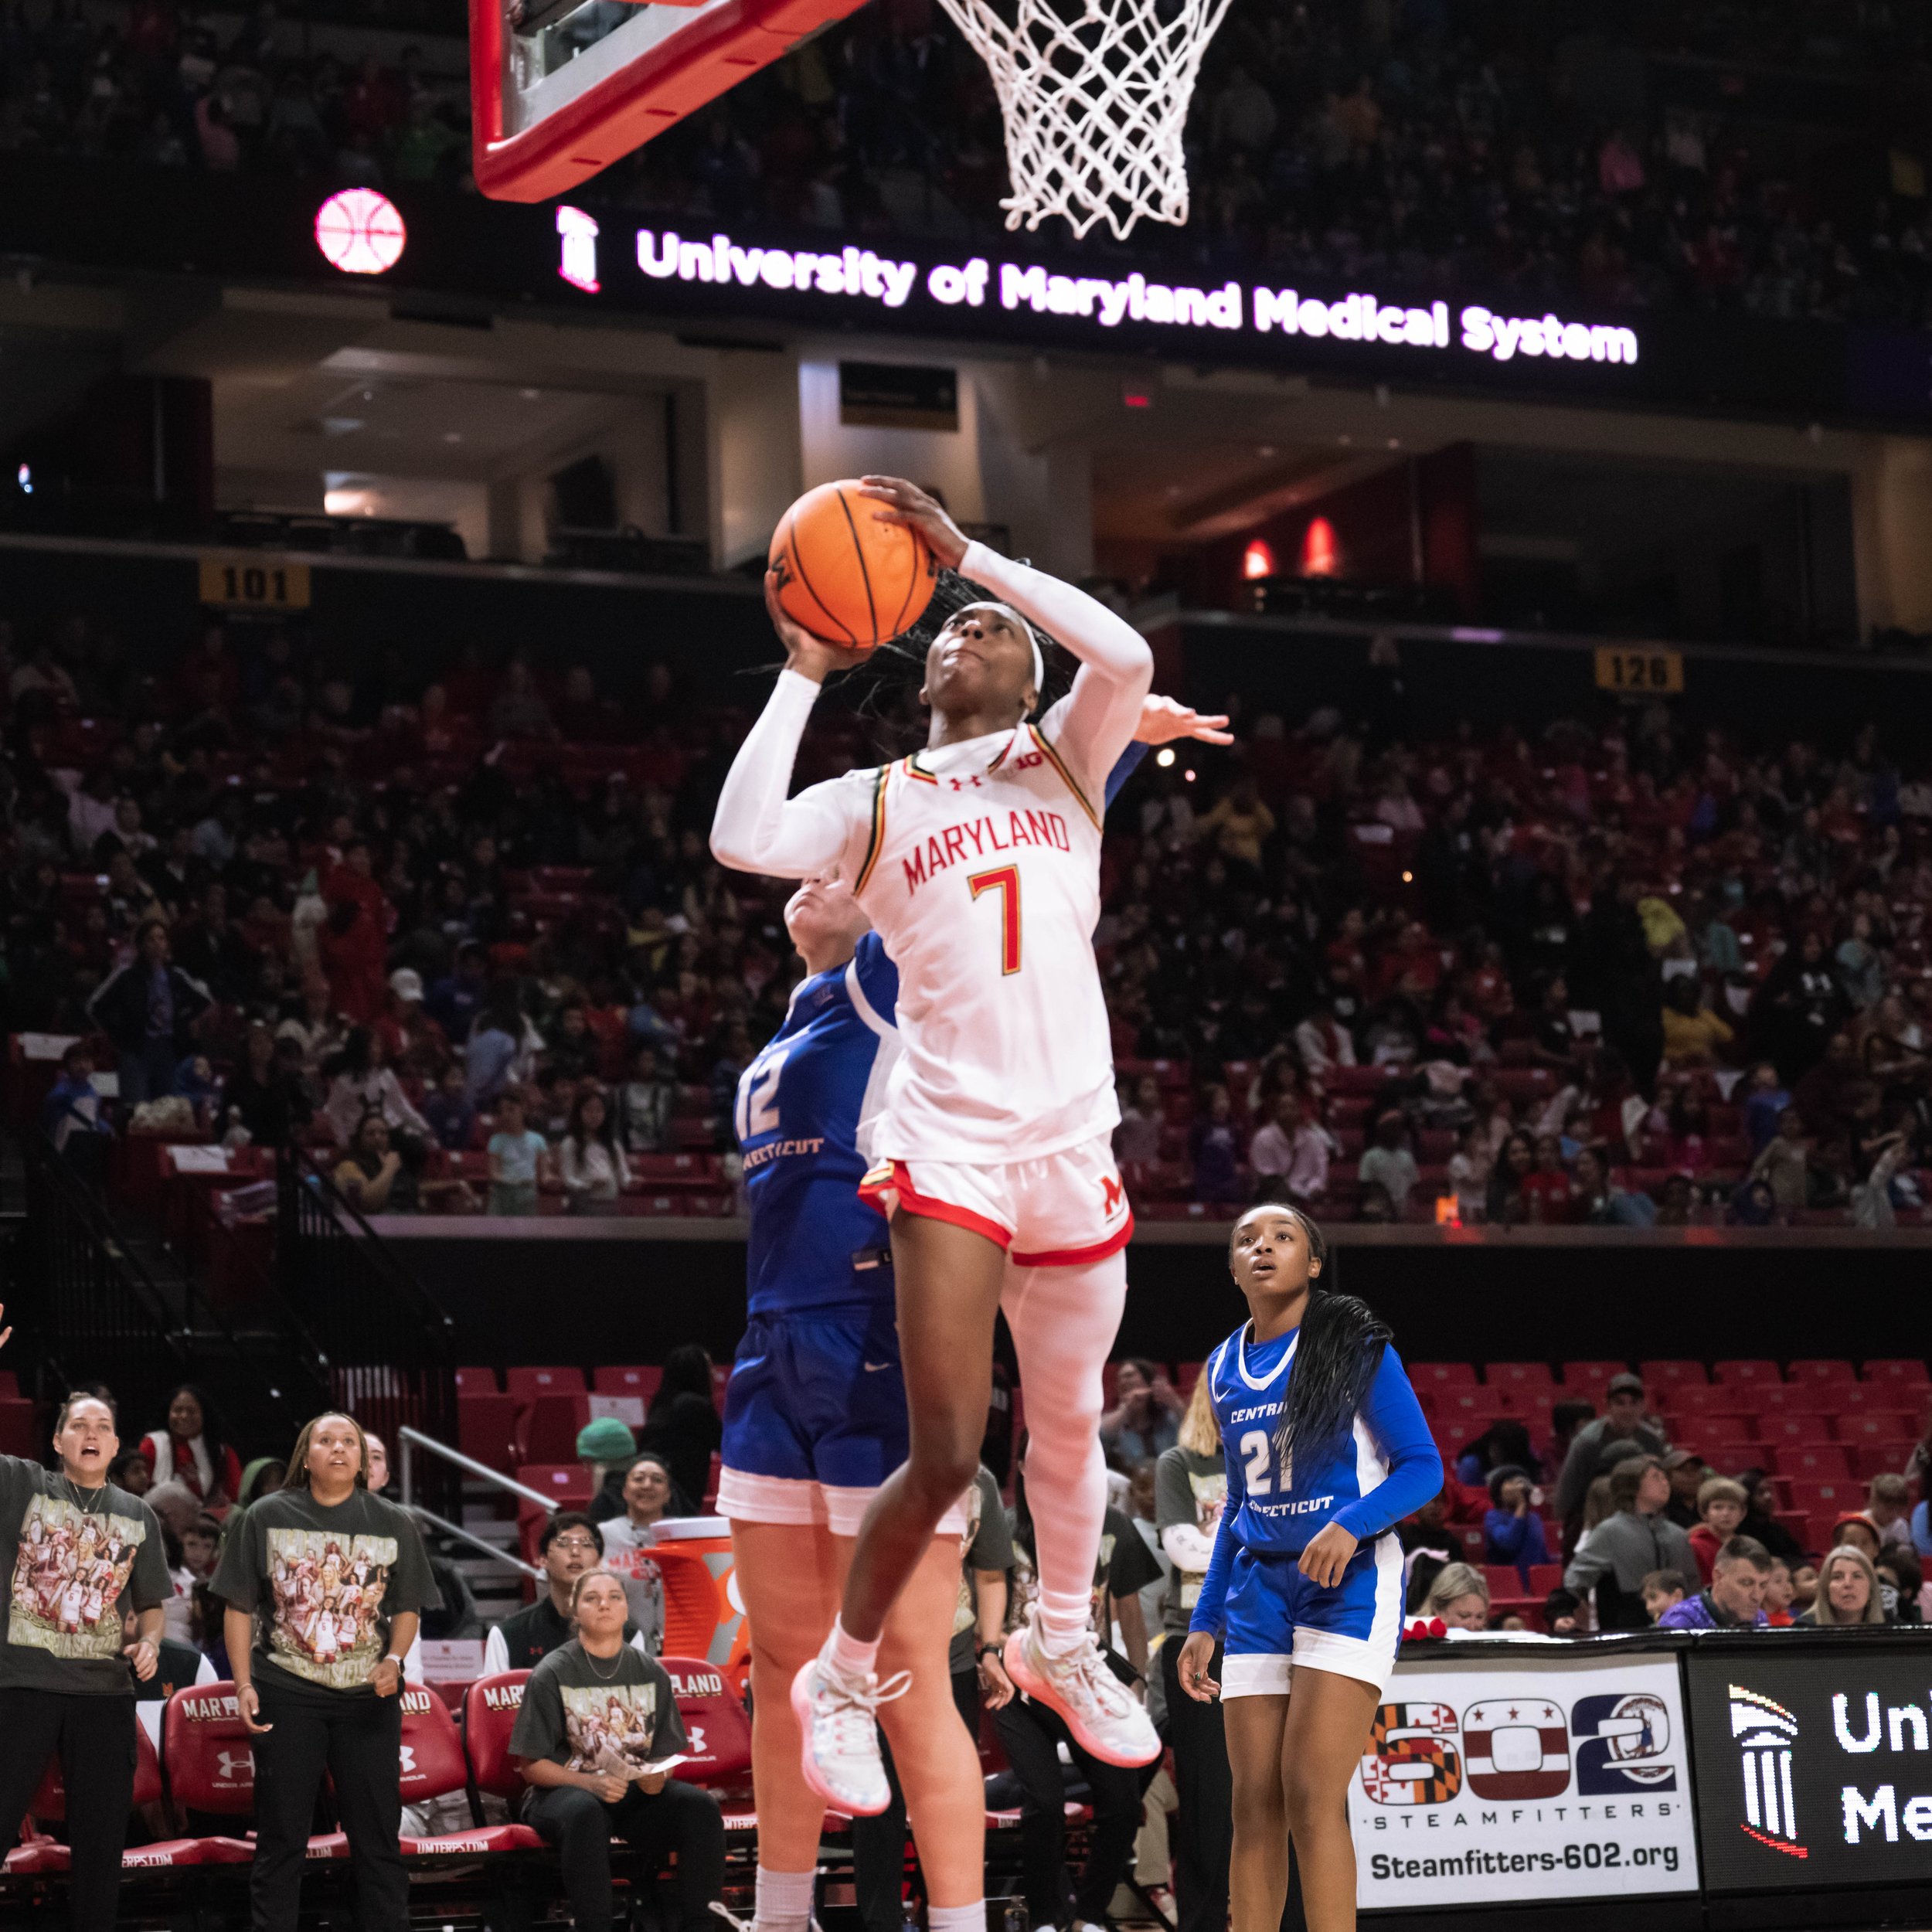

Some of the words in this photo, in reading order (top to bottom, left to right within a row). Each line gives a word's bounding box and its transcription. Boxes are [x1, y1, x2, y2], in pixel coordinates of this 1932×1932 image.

[637, 230, 916, 307] University
[928, 257, 989, 306] of
[1001, 264, 1243, 328] Maryland
[1253, 287, 1449, 348] Medical
[1461, 305, 1638, 364] System
[223, 566, 287, 601] 101
[1611, 655, 1668, 686] 126
[902, 808, 1070, 896] MARYLAND
[967, 863, 1021, 976] 7
[735, 1049, 791, 1142] 12
[1240, 1426, 1294, 1497] 21
[1361, 1693, 1677, 1806] 602
[1832, 1692, 1932, 1753] Un
[1373, 1801, 1672, 1831] STEAMFITTERS
[1841, 1785, 1932, 1844] Me
[1371, 1842, 1680, 1880] Steamfitters-602.org
